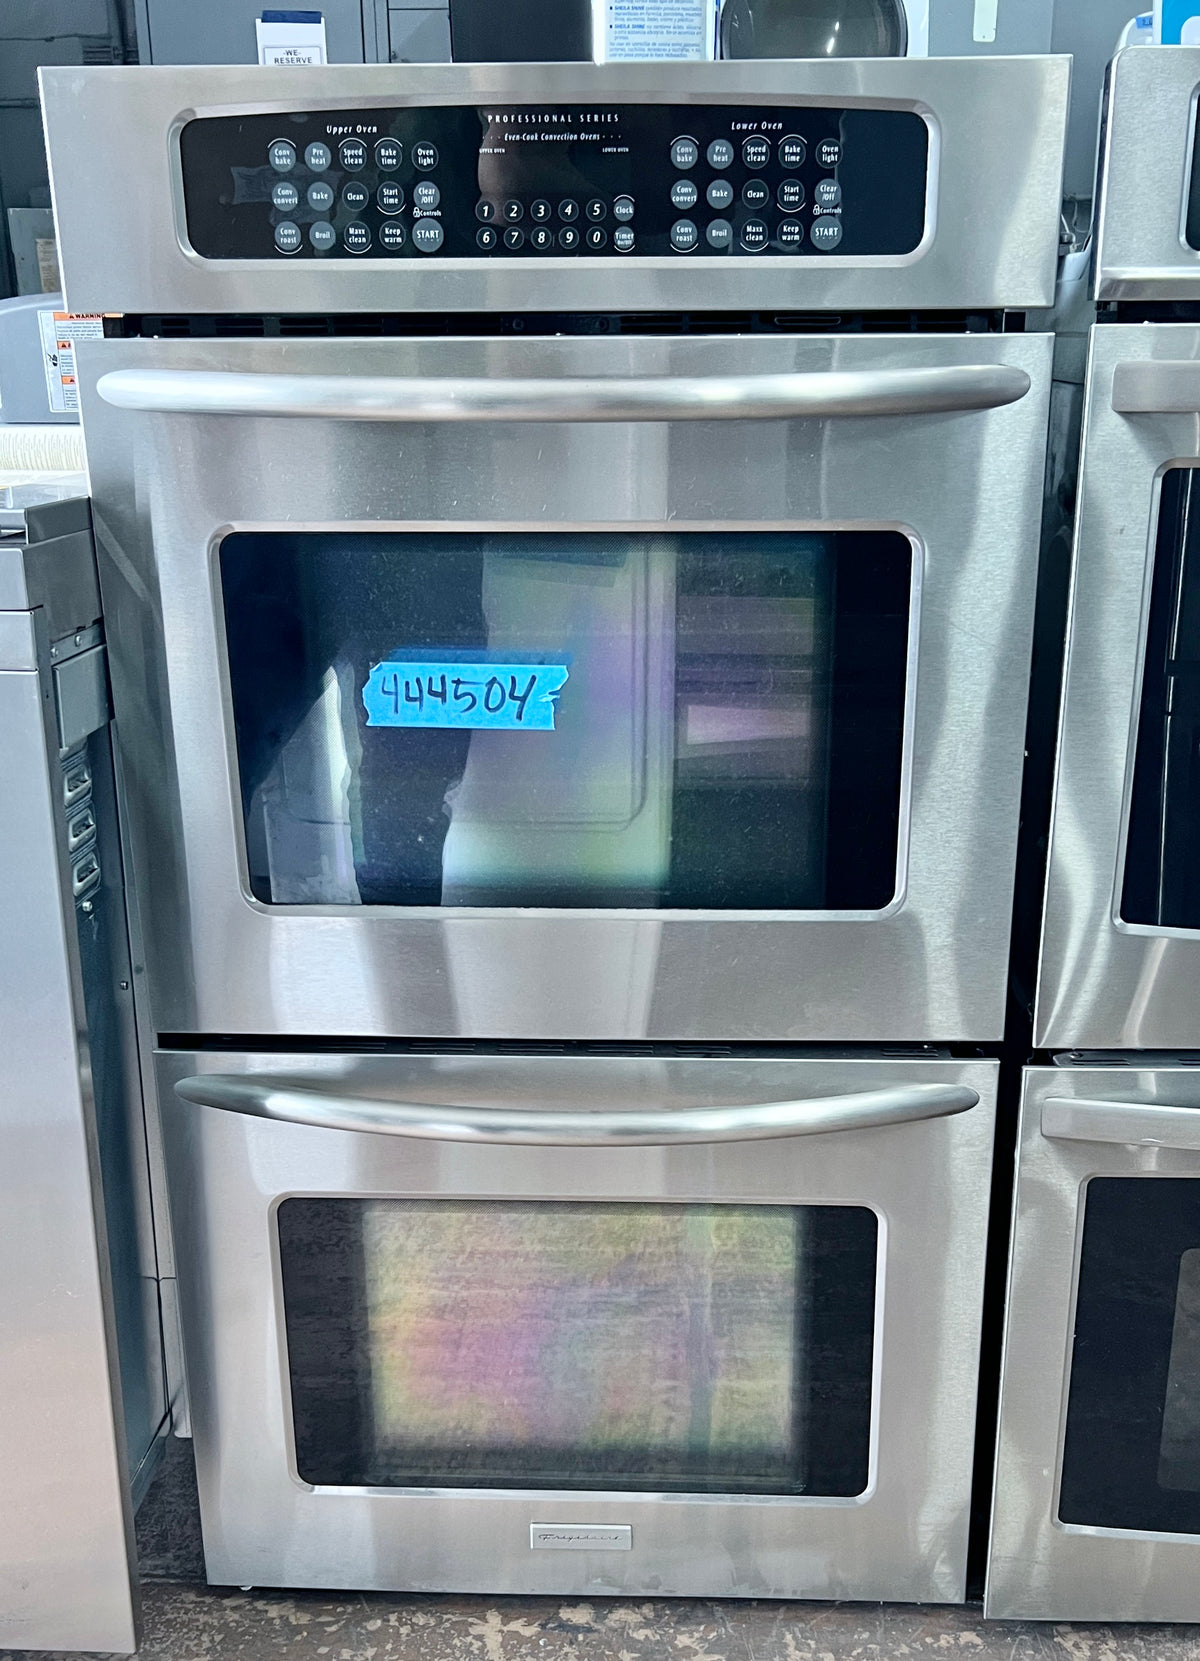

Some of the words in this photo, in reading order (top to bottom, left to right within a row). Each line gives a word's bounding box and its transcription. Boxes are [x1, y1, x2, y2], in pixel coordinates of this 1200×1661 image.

[488, 114, 572, 123] PROFESSIONAL
[580, 114, 619, 122] SERIES
[326, 125, 353, 135] Upper
[356, 124, 378, 134] Oven
[731, 122, 758, 130] Lower
[761, 121, 783, 130] Oven
[504, 132, 539, 141] Even-Cook
[540, 132, 578, 140] Convection
[580, 132, 600, 140] Ovens
[274, 148, 291, 156] Conv
[312, 148, 324, 156] Pre
[380, 148, 397, 156] Bake
[417, 148, 434, 156] Oven
[676, 146, 693, 154] Conv
[715, 146, 727, 154] Pre
[746, 146, 766, 154] Speed
[784, 145, 800, 153] Bake
[822, 144, 839, 153] Oven
[343, 148, 363, 158] Speed
[275, 157, 291, 165] bake
[311, 157, 326, 165] heat
[344, 157, 363, 165] clean
[381, 157, 397, 165] time
[418, 157, 434, 166] light
[676, 154, 692, 162] bake
[714, 154, 728, 162] heat
[747, 154, 766, 162] clean
[784, 154, 800, 162] time
[822, 154, 838, 163] light
[277, 188, 293, 196] Conv
[382, 188, 398, 196] Start
[418, 187, 436, 196] Clear
[676, 186, 692, 194] Conv
[784, 186, 800, 194] Start
[820, 184, 838, 192] Clear
[312, 192, 328, 200] Bake
[347, 192, 364, 200] Clean
[672, 194, 697, 202] convert
[712, 190, 728, 198] Bake
[784, 194, 800, 202] time
[274, 196, 298, 205] convert
[383, 196, 399, 204] time
[482, 206, 489, 217] 1
[510, 206, 518, 216] 2
[537, 205, 545, 216] 3
[564, 204, 572, 215] 4
[592, 204, 600, 215] 5
[280, 228, 296, 236] Conv
[349, 227, 366, 235] Maxx
[385, 227, 400, 236] Keep
[676, 226, 692, 234] Conv
[783, 226, 799, 234] Keep
[815, 228, 838, 236] START
[316, 231, 331, 239] Broil
[416, 230, 440, 239] START
[482, 232, 490, 243] 6
[510, 232, 519, 243] 7
[538, 232, 546, 243] 8
[566, 232, 574, 243] 9
[592, 232, 600, 243] 0
[676, 234, 692, 242] roast
[746, 233, 764, 242] clean
[280, 236, 297, 244] roast
[349, 236, 366, 244] clean
[381, 674, 537, 721] 444504
